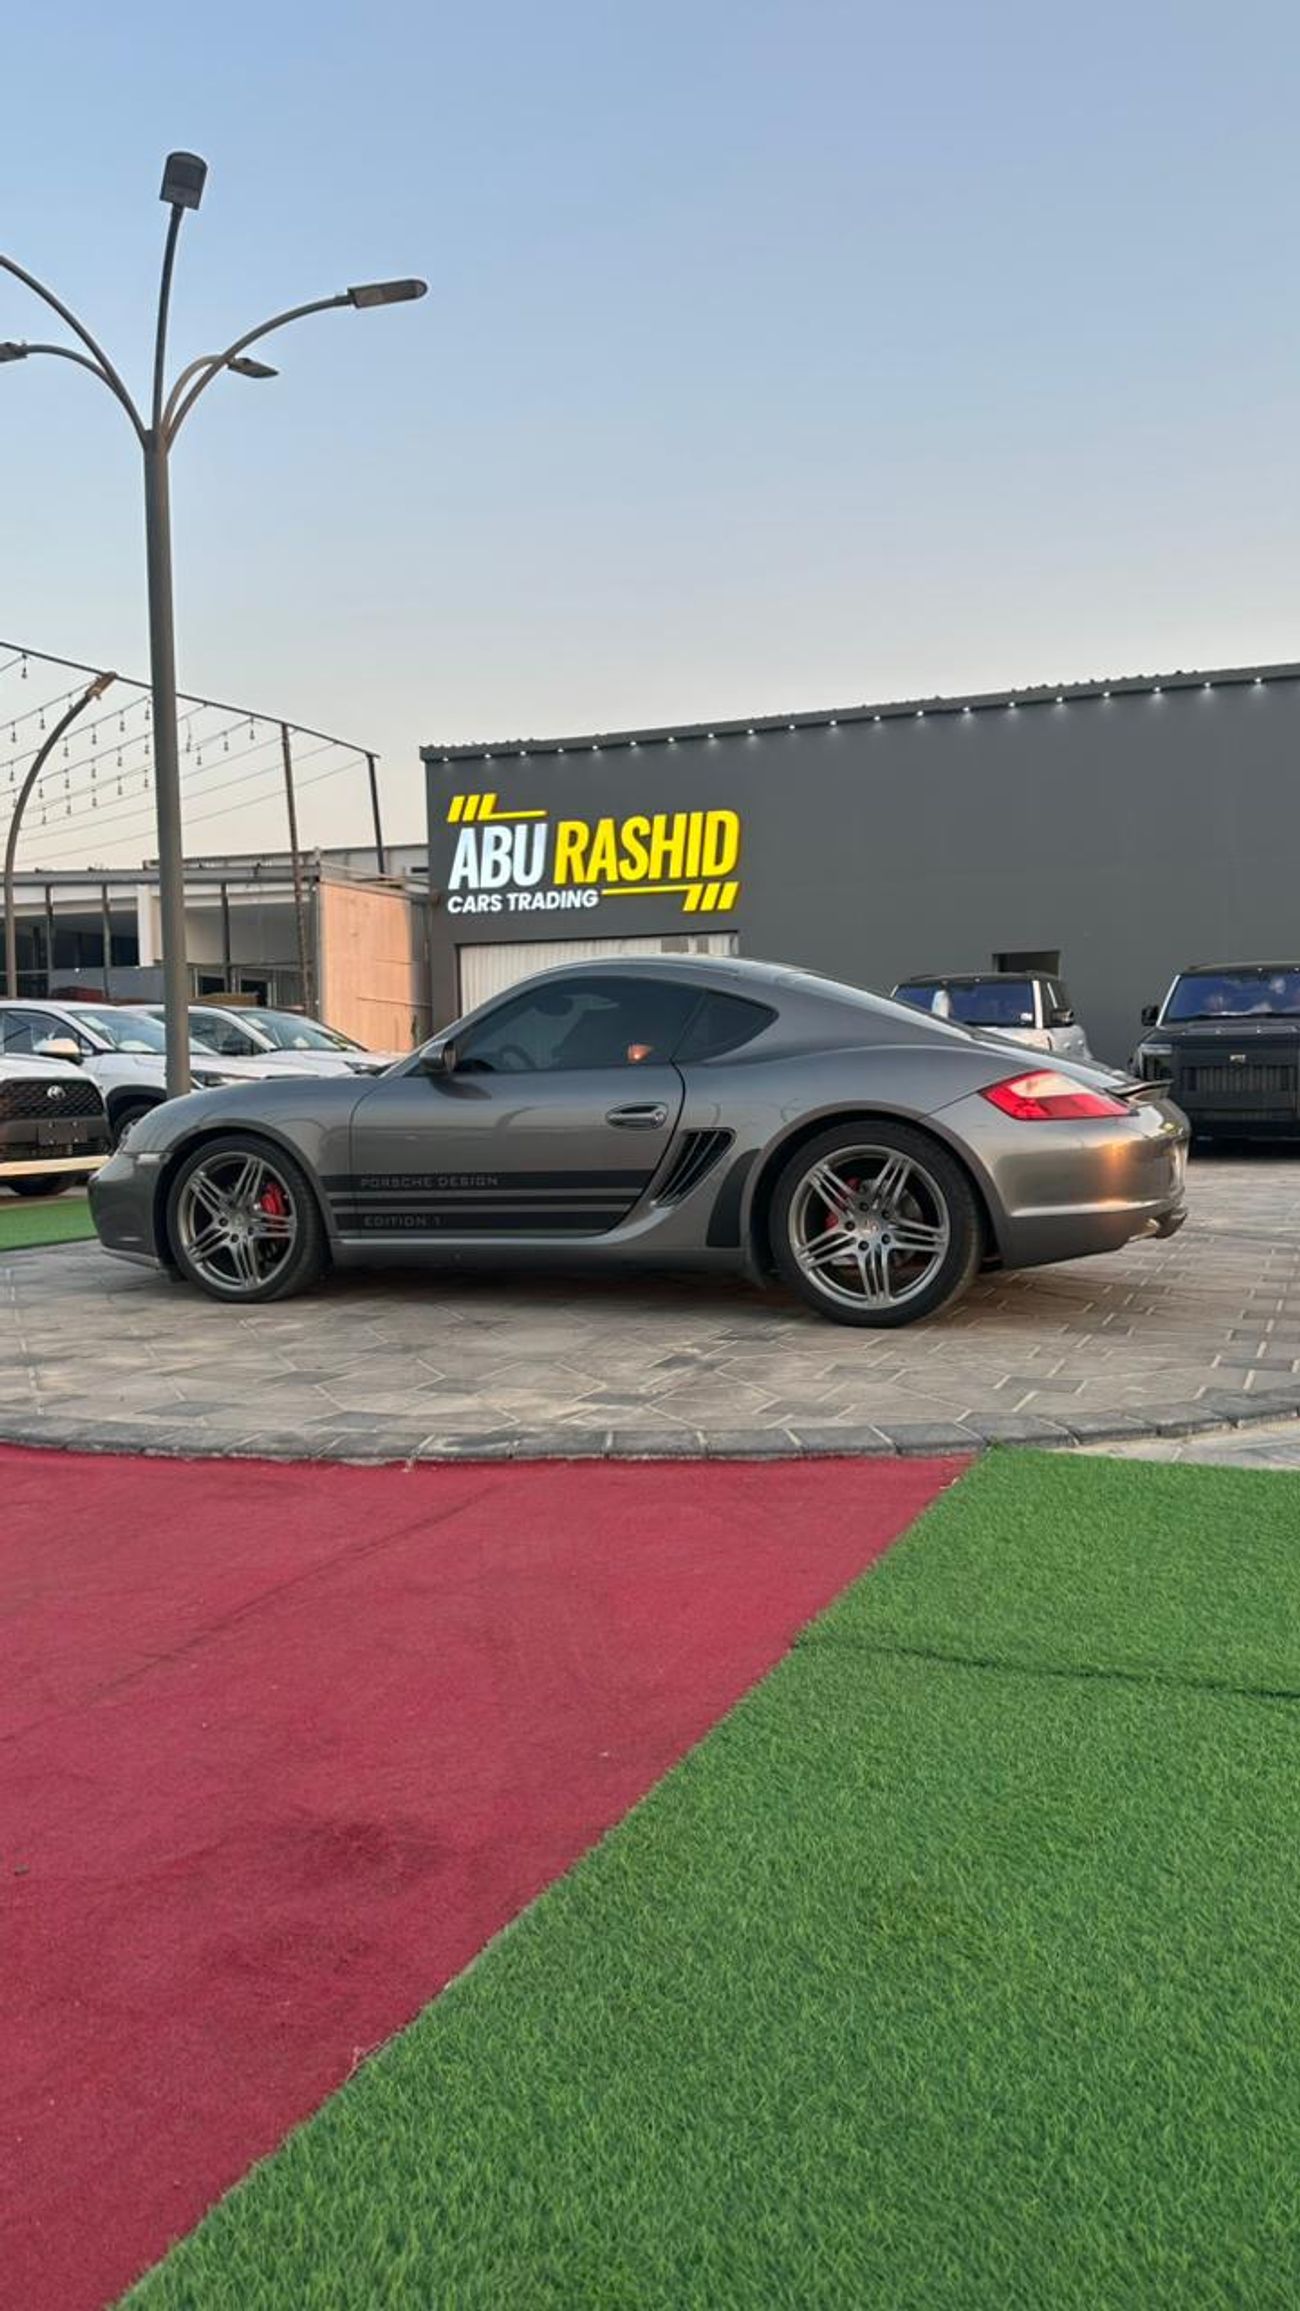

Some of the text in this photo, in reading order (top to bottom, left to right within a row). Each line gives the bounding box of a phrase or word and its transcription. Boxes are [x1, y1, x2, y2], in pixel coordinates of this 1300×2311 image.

[448, 810, 741, 889] ABU RASHID
[447, 889, 599, 913] CARS TRADING
[360, 1175, 498, 1188] PORSCHE DESIGN
[363, 1215, 441, 1227] EDITION 1
